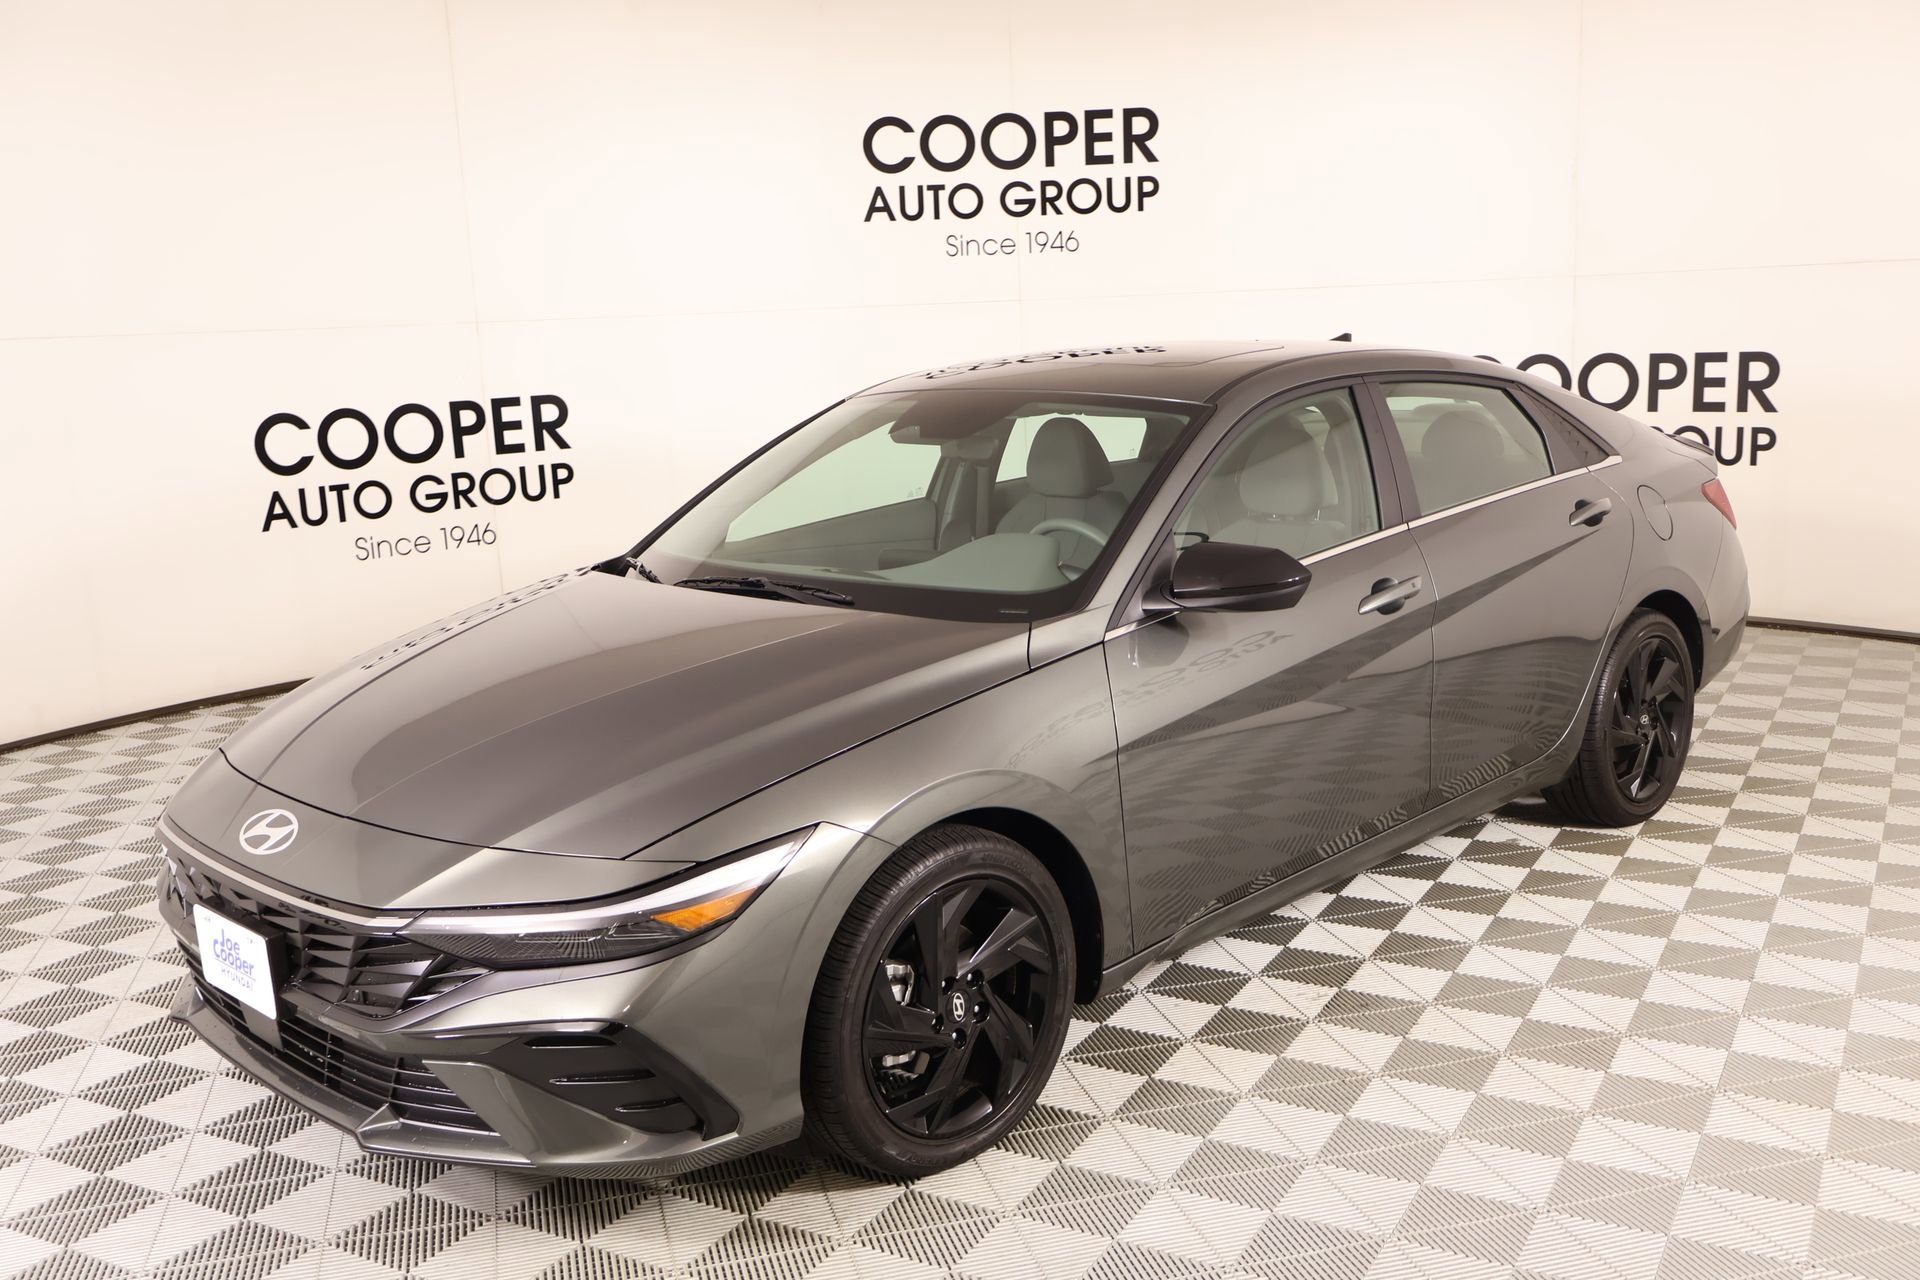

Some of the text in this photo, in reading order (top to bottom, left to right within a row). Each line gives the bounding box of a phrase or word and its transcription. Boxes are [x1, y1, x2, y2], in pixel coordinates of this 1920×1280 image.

[862, 106, 1160, 175] COOPER
[863, 175, 1160, 223] AUTO GROUP
[946, 230, 1080, 257] Since 1946
[1474, 351, 1780, 413] OPER
[253, 394, 572, 477] COOPER
[261, 462, 575, 533] AUTO GROUP
[354, 522, 497, 561] Since 1946
[213, 938, 255, 976] Cooper
[220, 928, 240, 956] Joe
